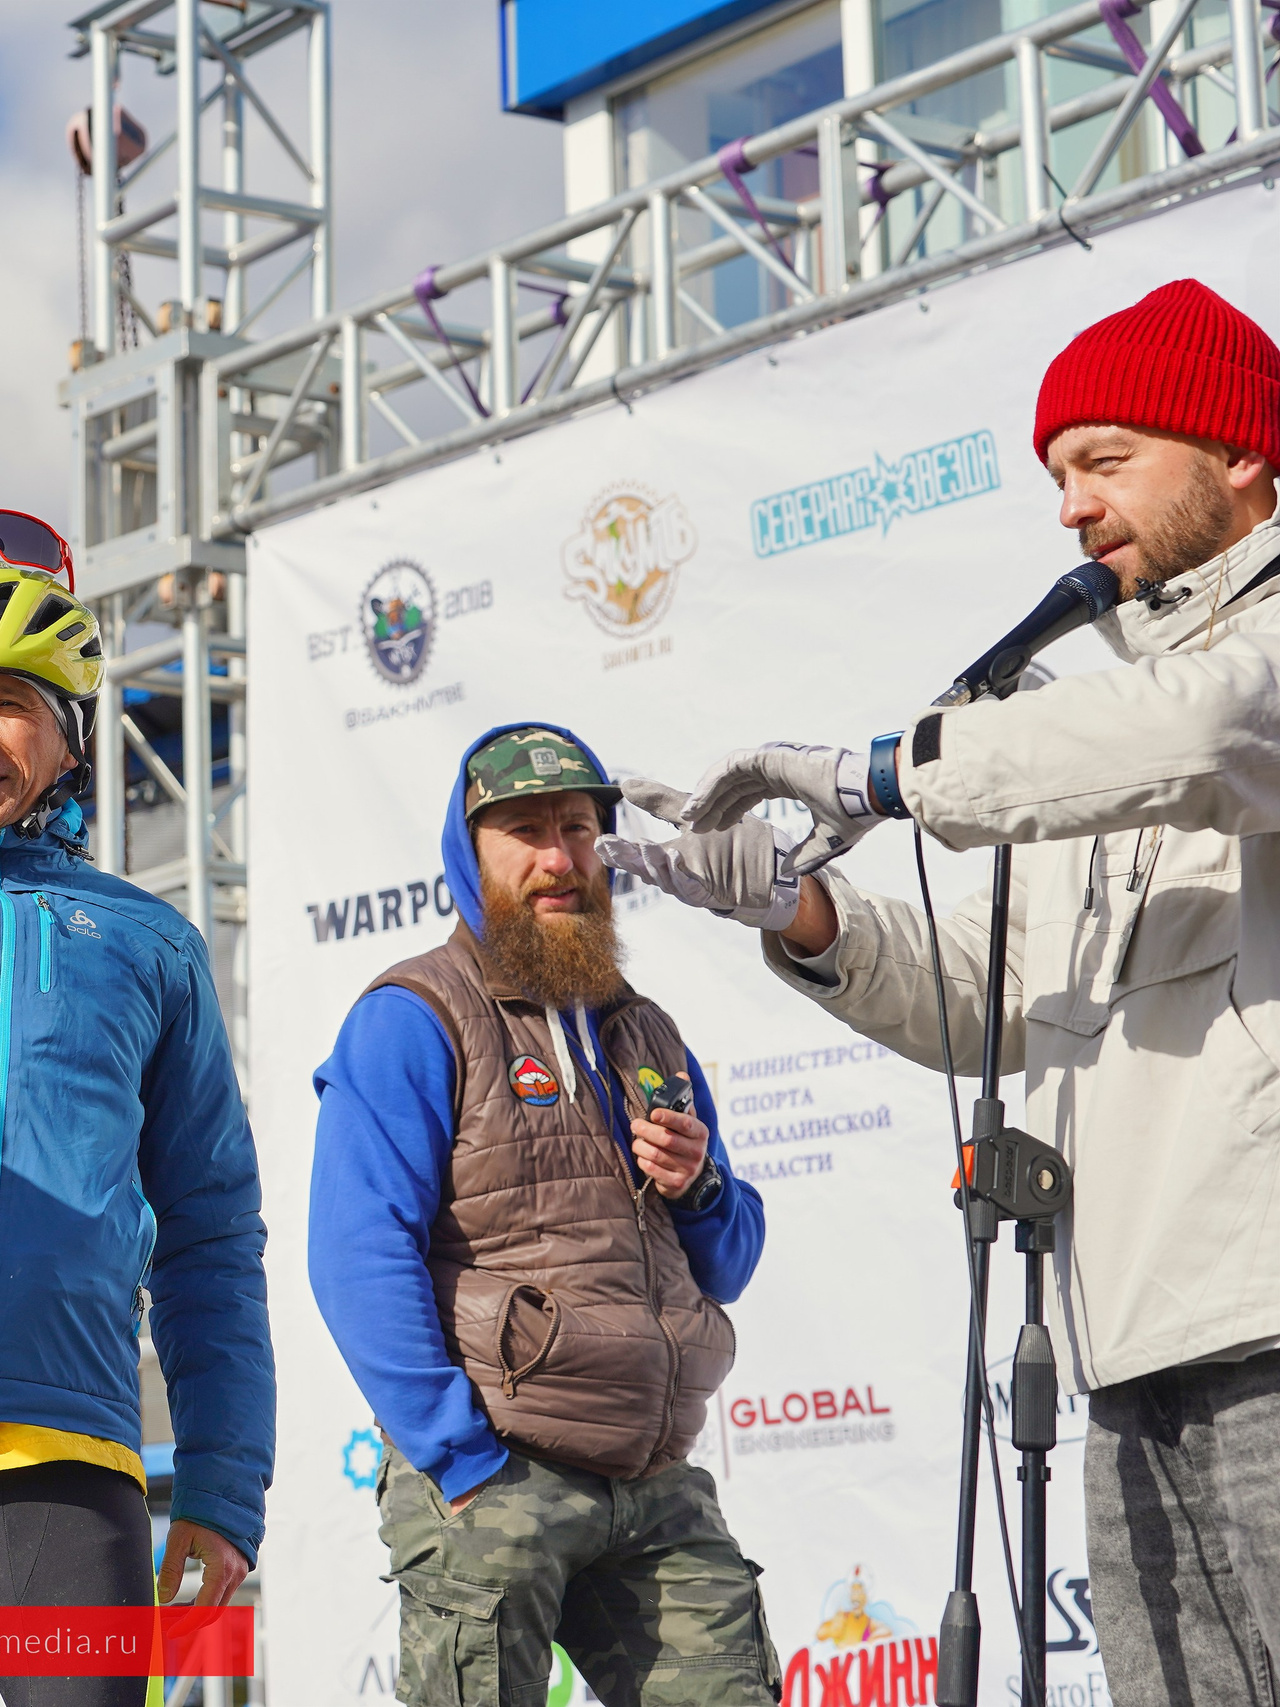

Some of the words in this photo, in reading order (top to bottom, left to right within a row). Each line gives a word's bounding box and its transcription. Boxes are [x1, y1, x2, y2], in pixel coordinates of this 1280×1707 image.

[751, 467, 874, 557] СЕВЕРНАЯ
[901, 431, 1001, 511] ЗВЕЗДА
[443, 579, 494, 619] 2018
[66, 924, 102, 940] odlo
[729, 1040, 898, 1084] МИНИСТЕРСТВ
[729, 1086, 815, 1118] СПОРТА
[730, 1103, 893, 1151] САХАЛИНСКОЙ
[733, 1152, 834, 1182] ОБЛАСТИ
[730, 1386, 891, 1428] GLOBAL
[733, 1420, 896, 1456] ENGINEERING
